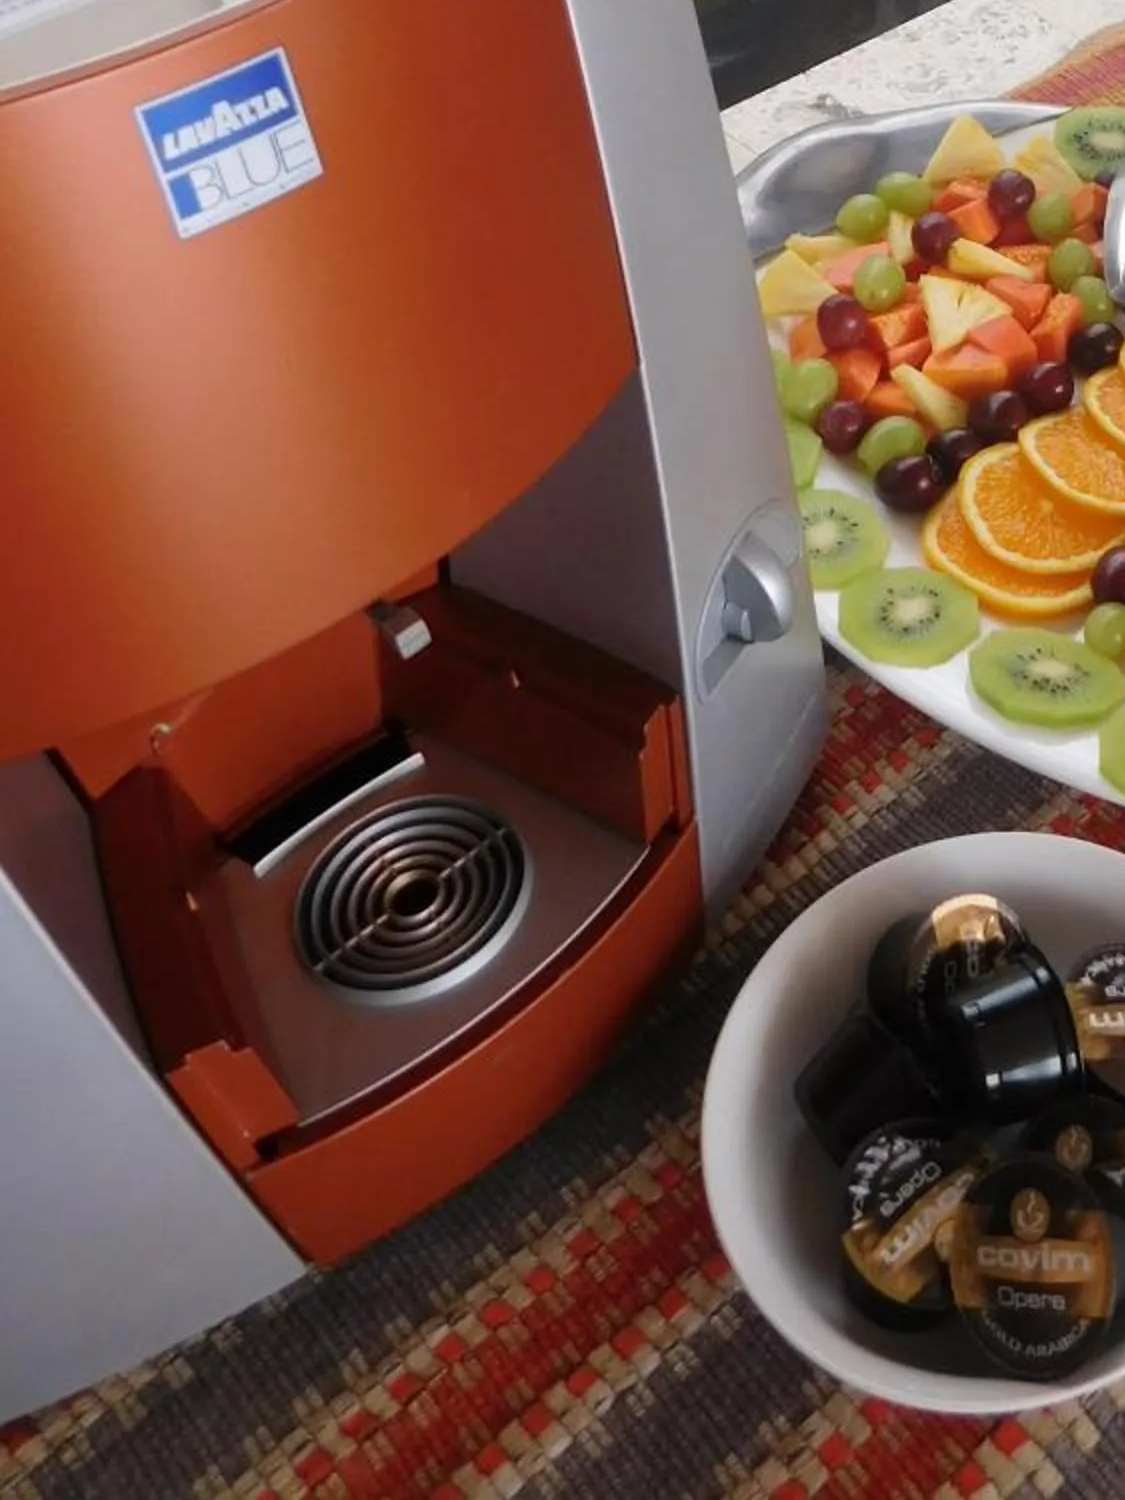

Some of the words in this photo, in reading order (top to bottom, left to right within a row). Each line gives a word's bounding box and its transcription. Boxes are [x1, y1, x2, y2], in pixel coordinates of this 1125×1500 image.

[188, 121, 314, 211] BLUE
[879, 1161, 943, 1218] Opera
[976, 1241, 1092, 1276] covim
[997, 1285, 1066, 1312] Opera
